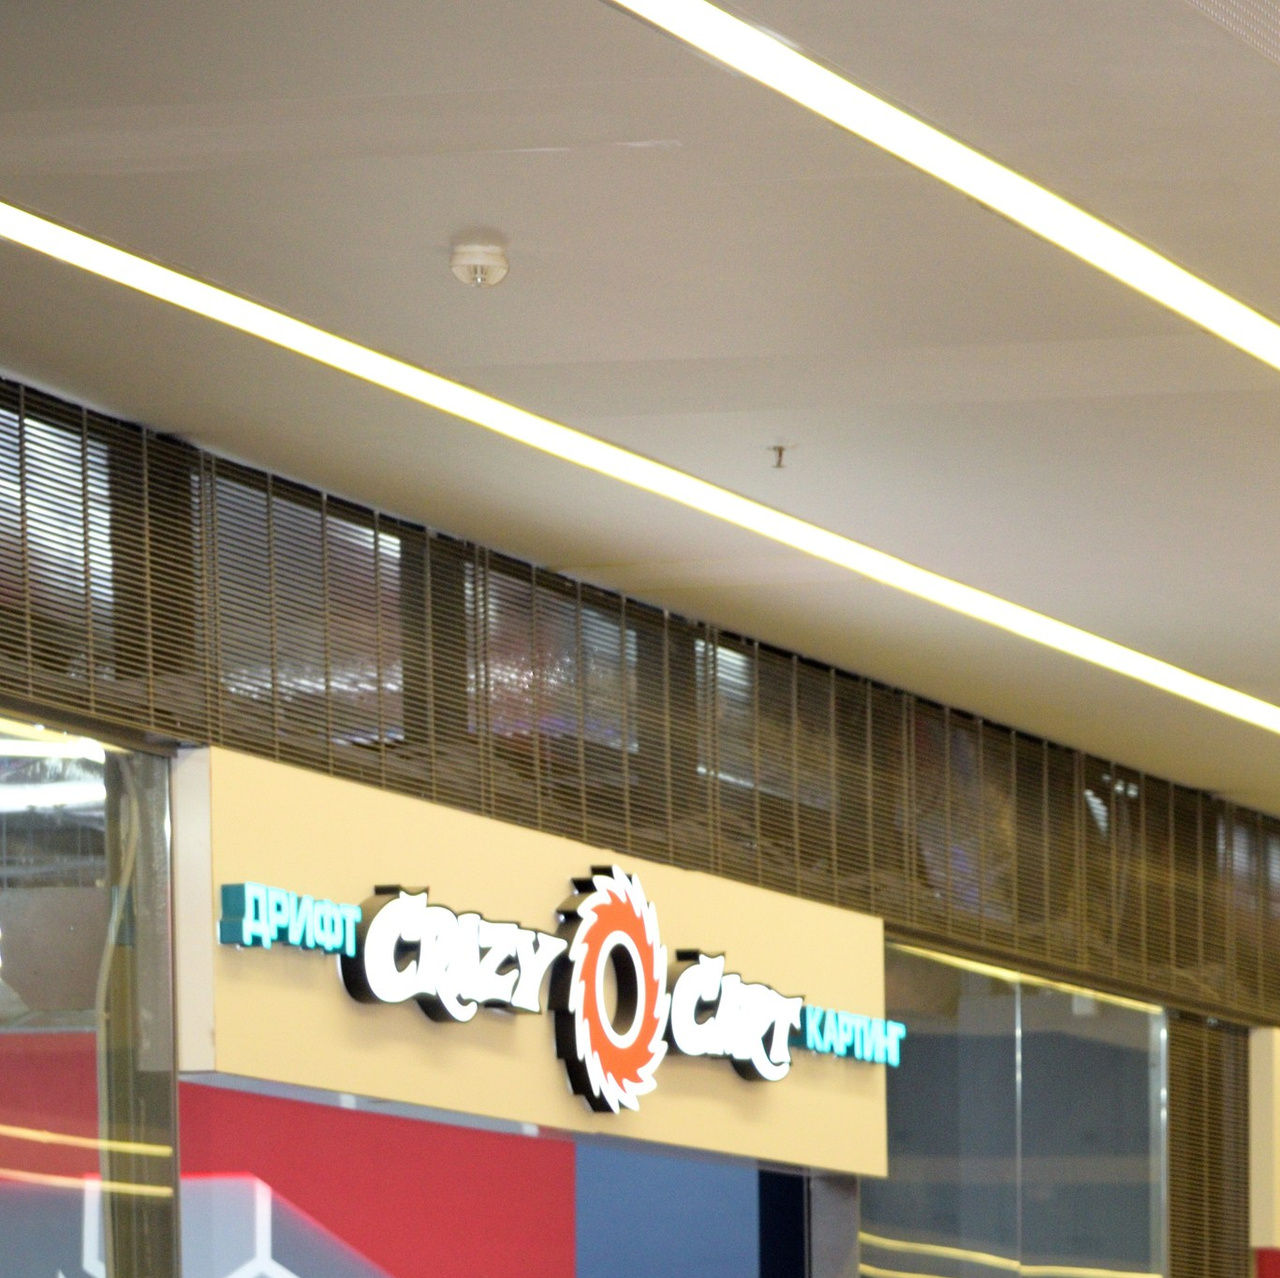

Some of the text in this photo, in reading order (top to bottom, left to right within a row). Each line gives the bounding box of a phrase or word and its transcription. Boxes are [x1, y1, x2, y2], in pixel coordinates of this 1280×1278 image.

[242, 881, 362, 958] ДРИФТ
[364, 890, 568, 1022] CRAZY
[805, 1004, 907, 1067] КАРТИНГ
